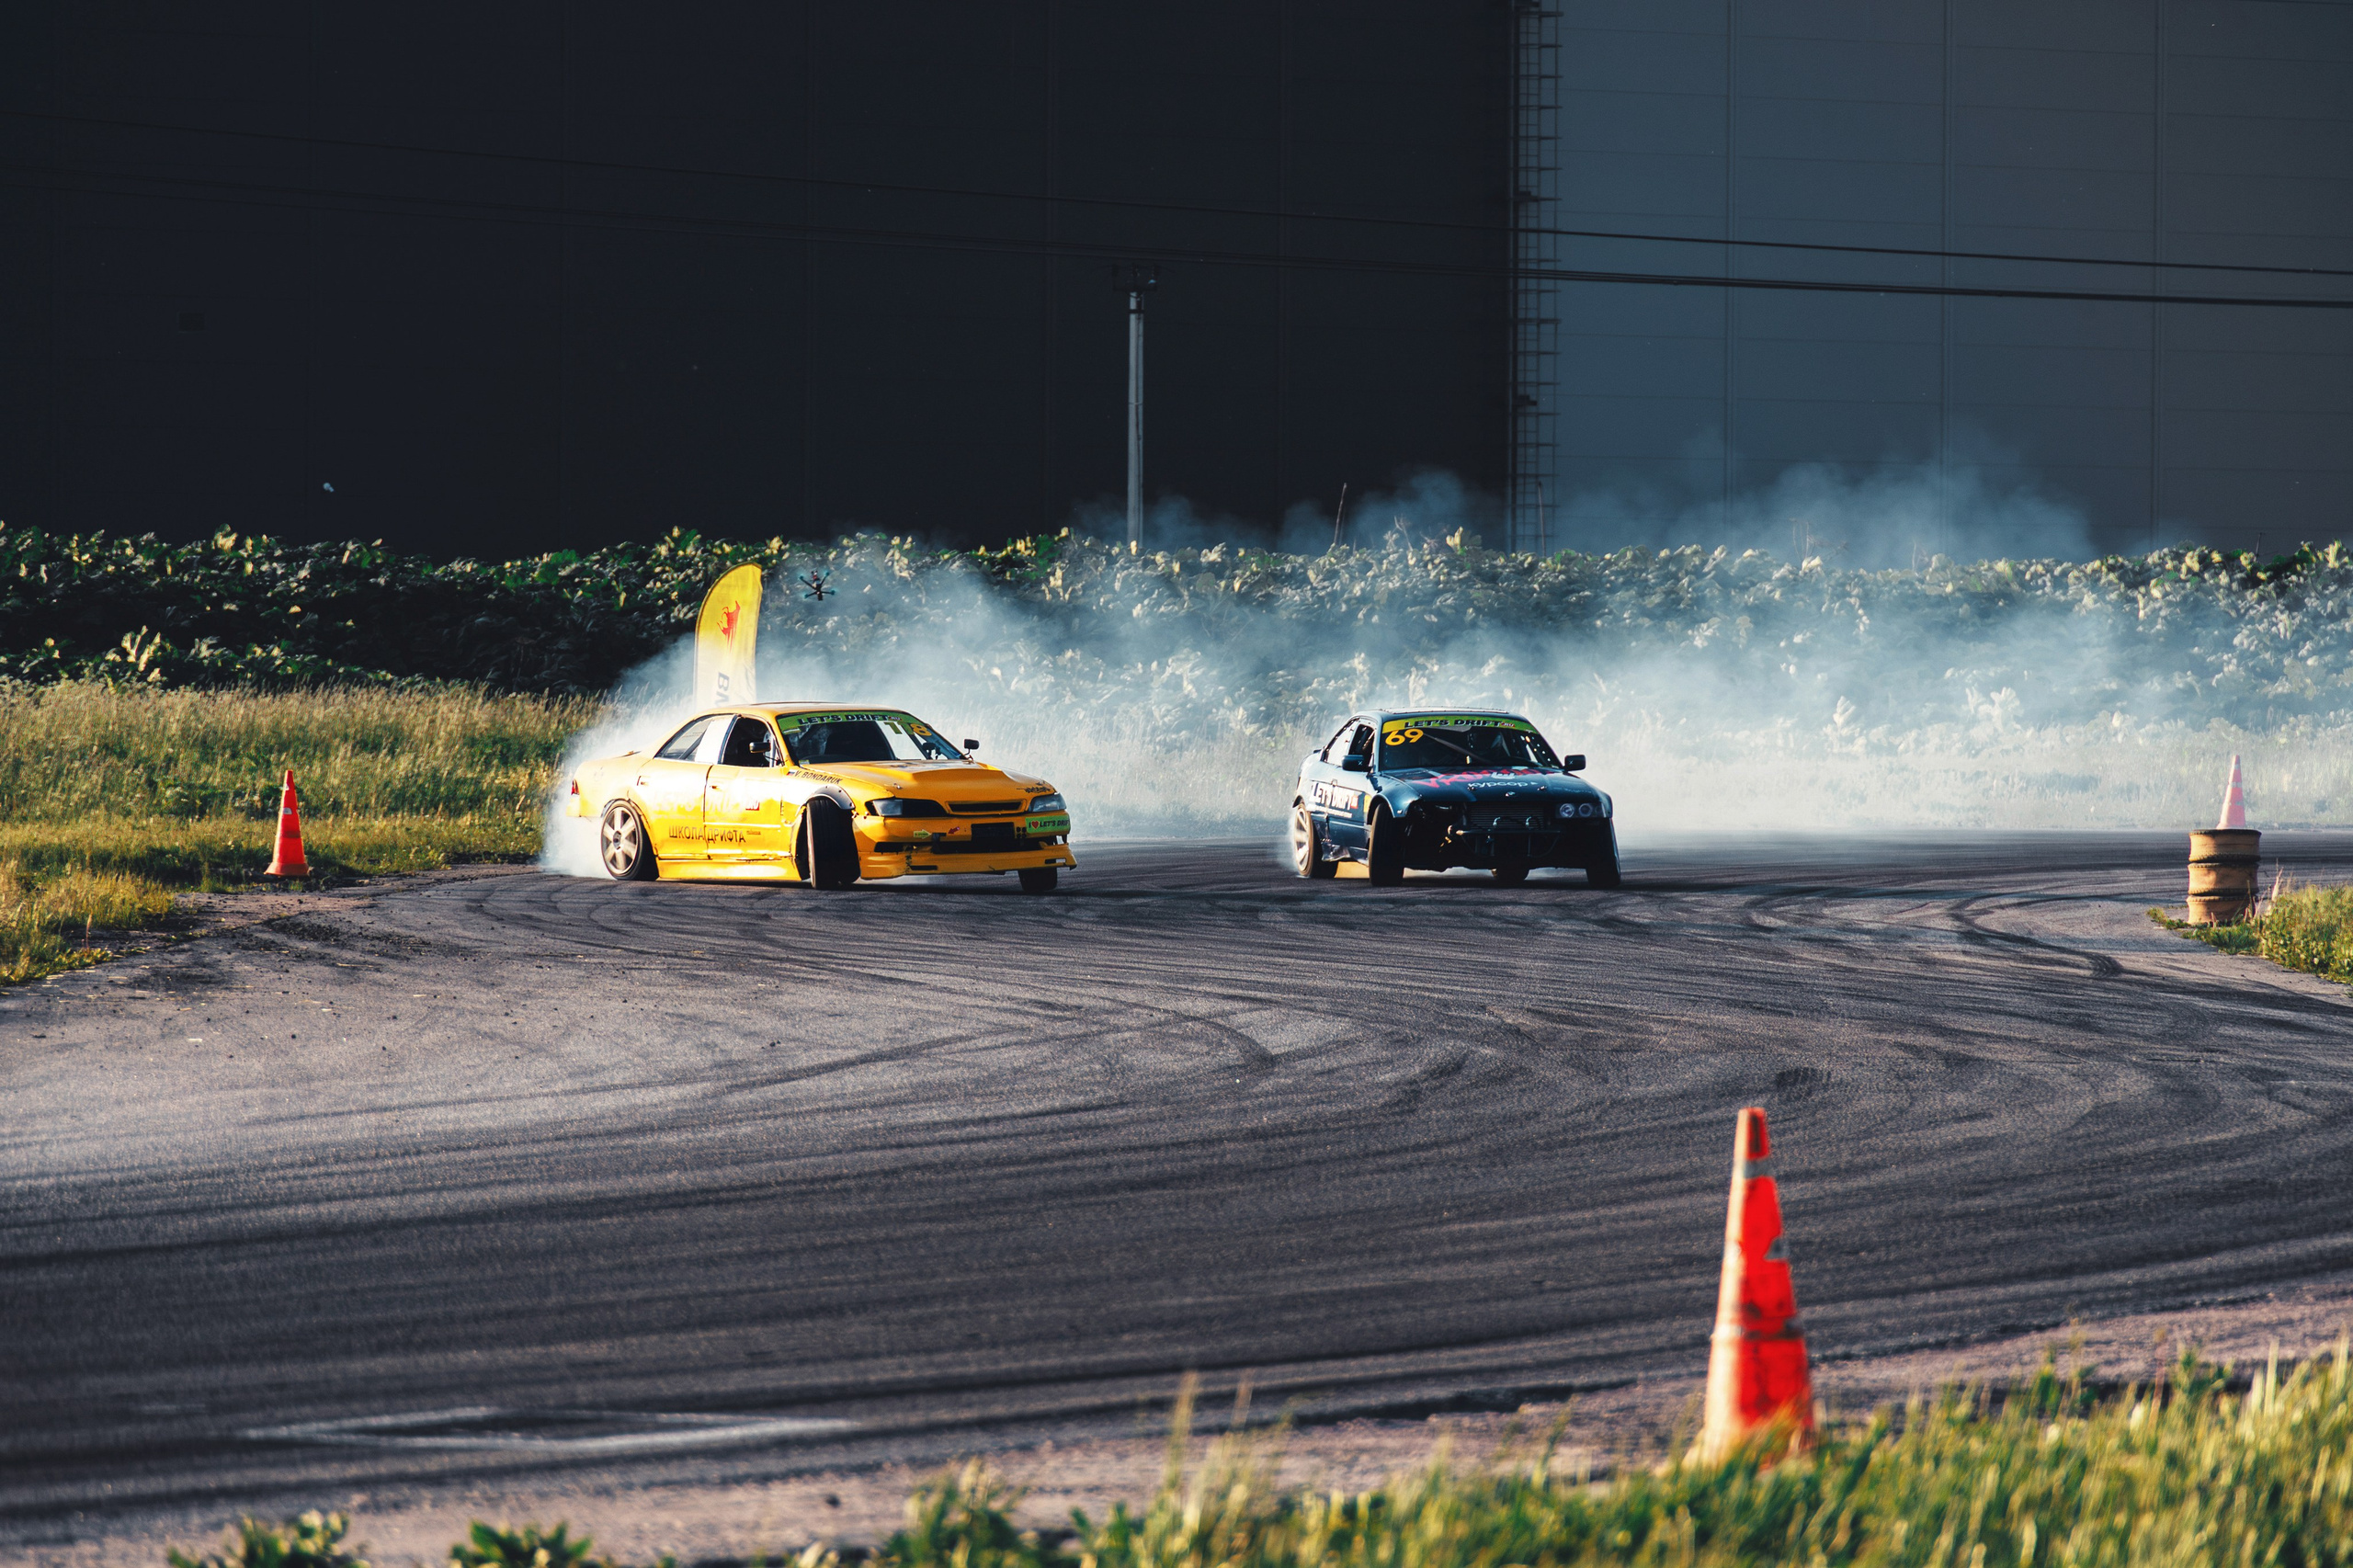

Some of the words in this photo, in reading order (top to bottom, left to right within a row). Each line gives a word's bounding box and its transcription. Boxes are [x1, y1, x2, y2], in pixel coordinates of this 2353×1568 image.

[798, 714, 842, 724] LET'S
[1404, 719, 1449, 728] LET'S
[1385, 728, 1424, 745] 69
[801, 771, 842, 784] BONDARUK
[668, 825, 705, 840] ШКОЛА
[707, 828, 746, 844] ДРИФТА
